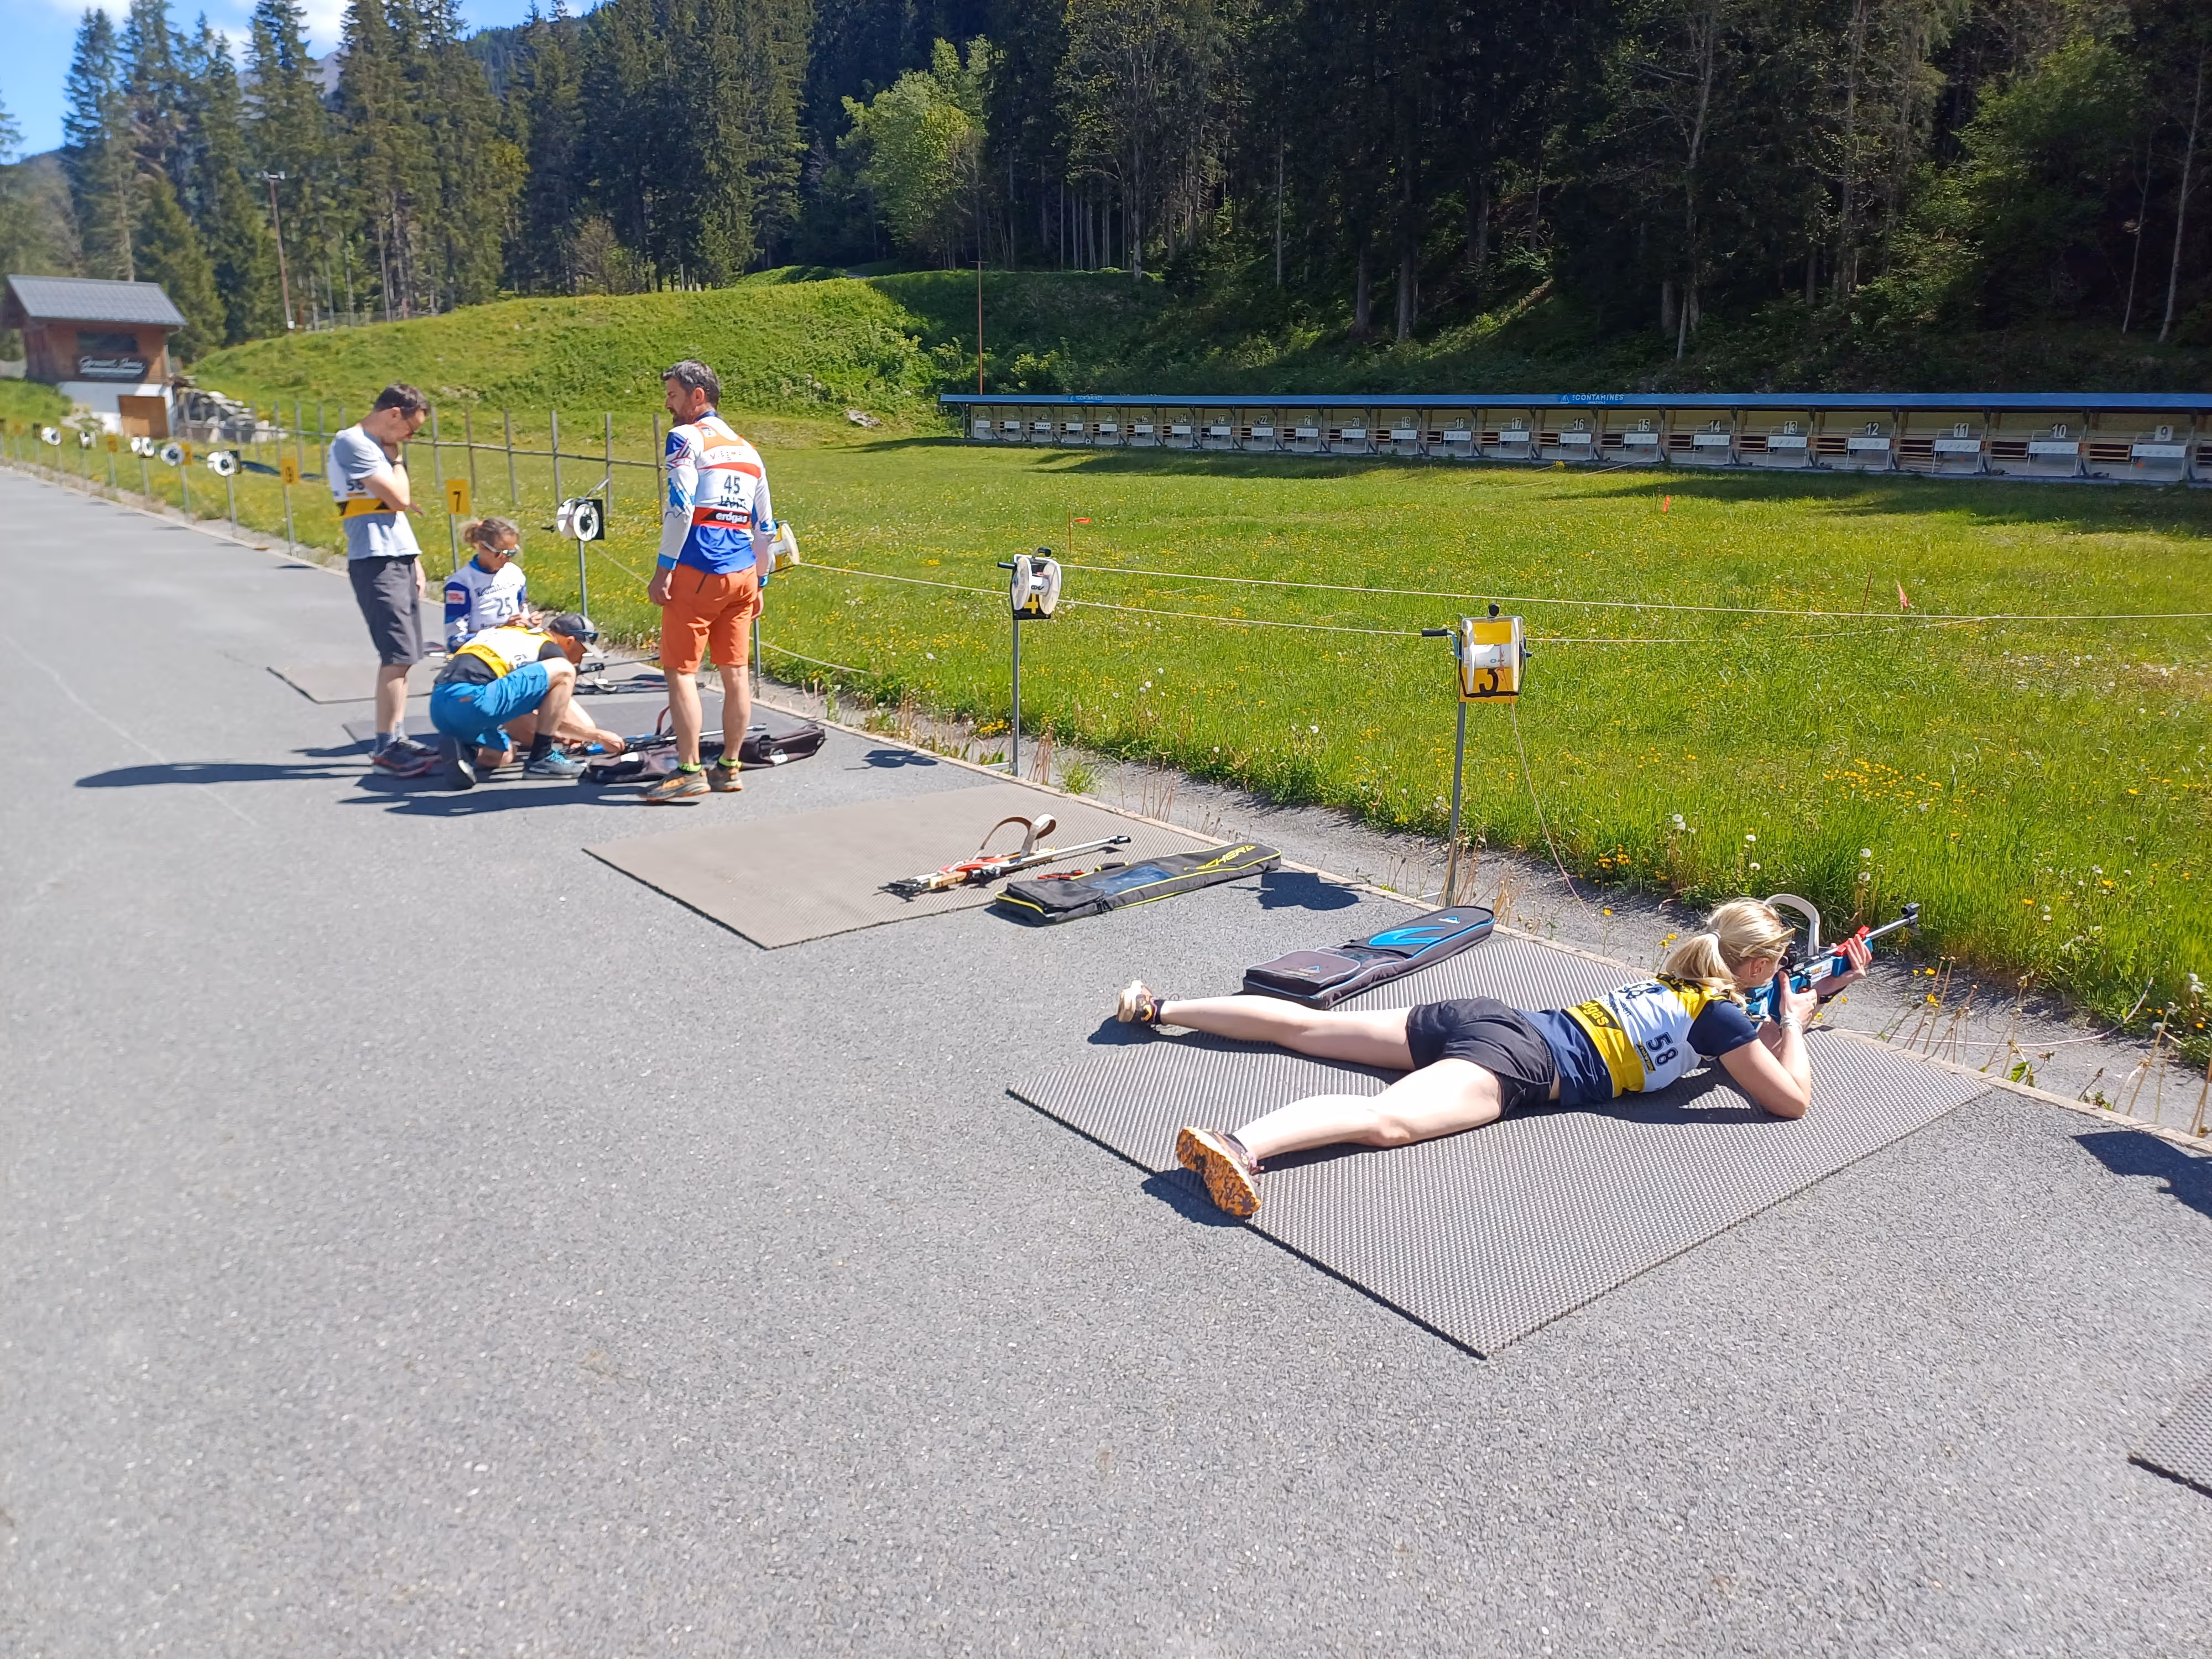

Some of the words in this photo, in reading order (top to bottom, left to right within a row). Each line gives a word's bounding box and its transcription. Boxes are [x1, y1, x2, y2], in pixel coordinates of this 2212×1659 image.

[1353, 417, 1360, 427] 20
[1402, 417, 1410, 427] 19
[1455, 418, 1464, 429] 18
[1512, 419, 1521, 429] 17
[1574, 419, 1584, 430] 16
[1639, 419, 1649, 431] 15
[1709, 420, 1720, 432] 14
[1785, 421, 1797, 434] 13
[1866, 422, 1880, 436] 12
[1955, 424, 1968, 437] 11
[2052, 425, 2067, 439] 10
[2161, 426, 2168, 440] 9
[723, 474, 740, 495] 45
[452, 490, 461, 513] 7
[496, 597, 513, 618] 25
[1582, 1001, 1609, 1026] dgas
[1646, 1031, 1678, 1067] 58
